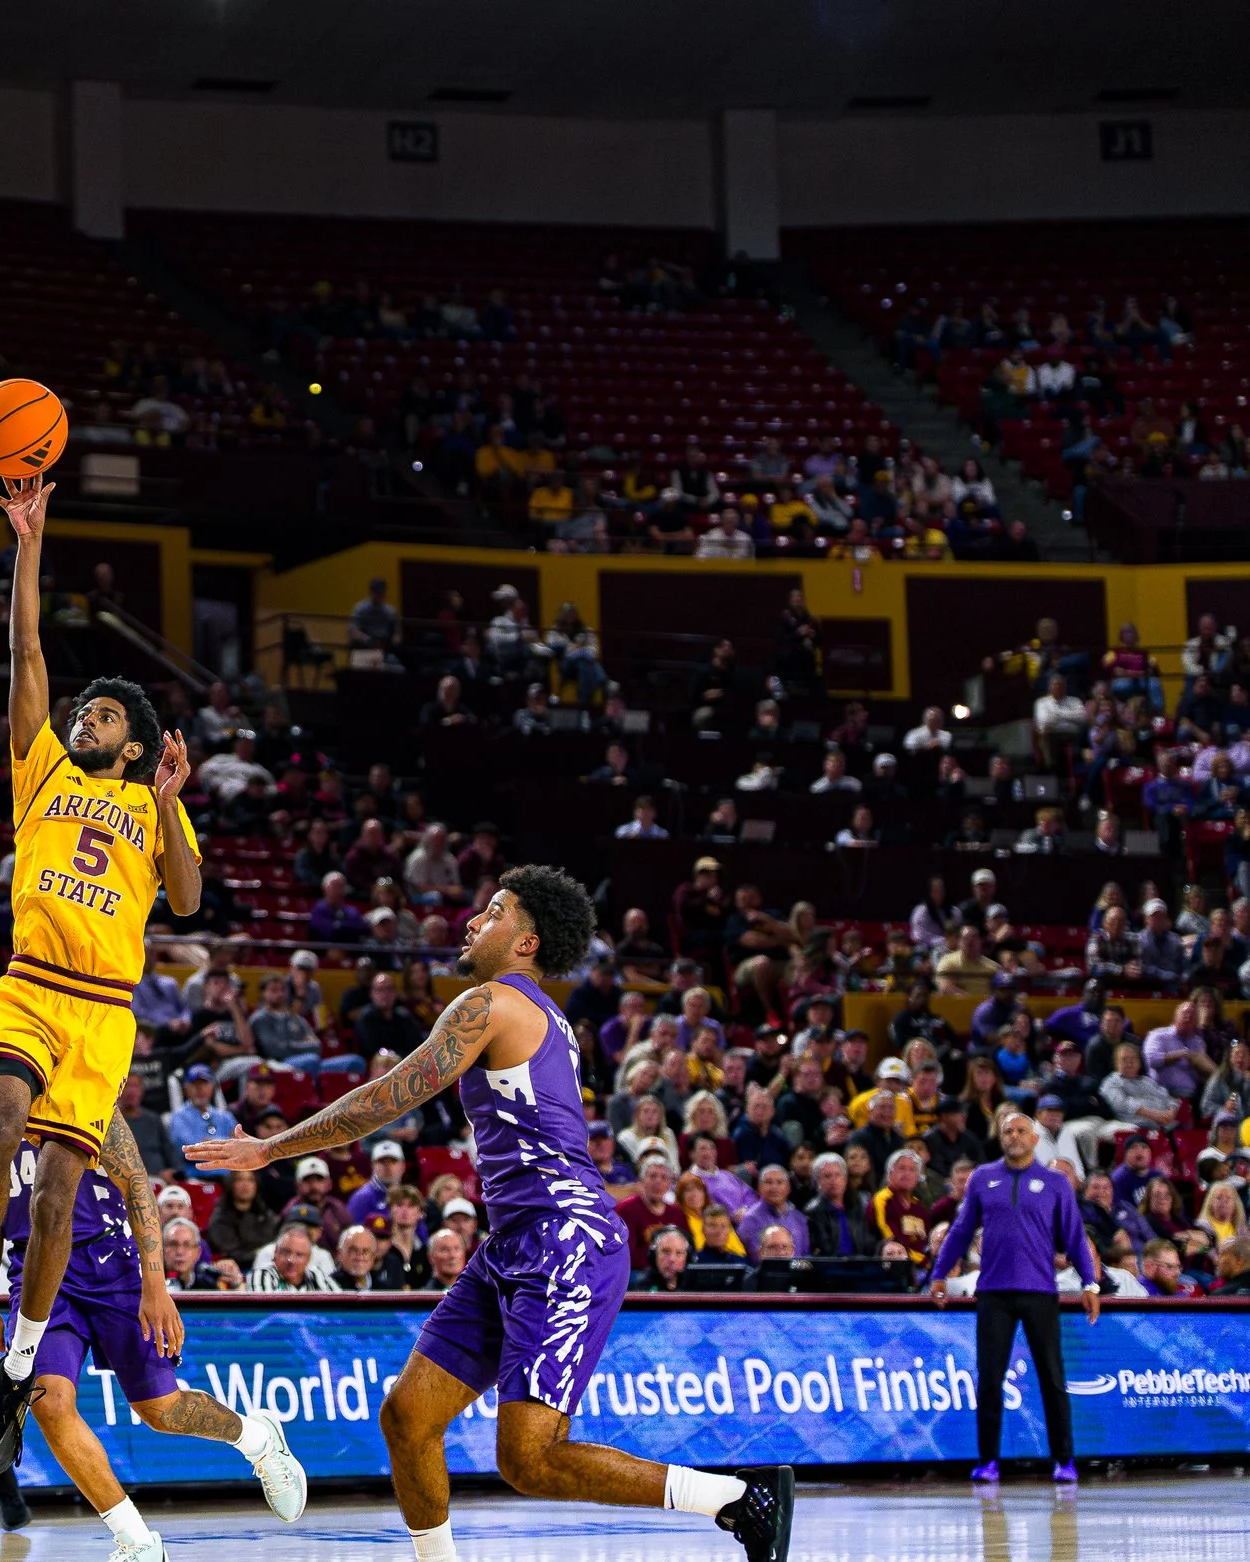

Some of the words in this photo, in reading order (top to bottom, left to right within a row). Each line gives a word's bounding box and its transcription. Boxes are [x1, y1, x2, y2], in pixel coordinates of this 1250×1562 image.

[392, 128, 433, 154] H2
[1111, 128, 1143, 155] J1
[43, 794, 145, 854] ARIZONA
[72, 825, 116, 877] 5
[38, 868, 123, 917] STATE
[575, 1354, 736, 1417] rusted
[743, 1353, 843, 1414] Pool
[852, 1353, 1023, 1412] Finishs
[1122, 1396, 1222, 1408] INTERNATIONAL
